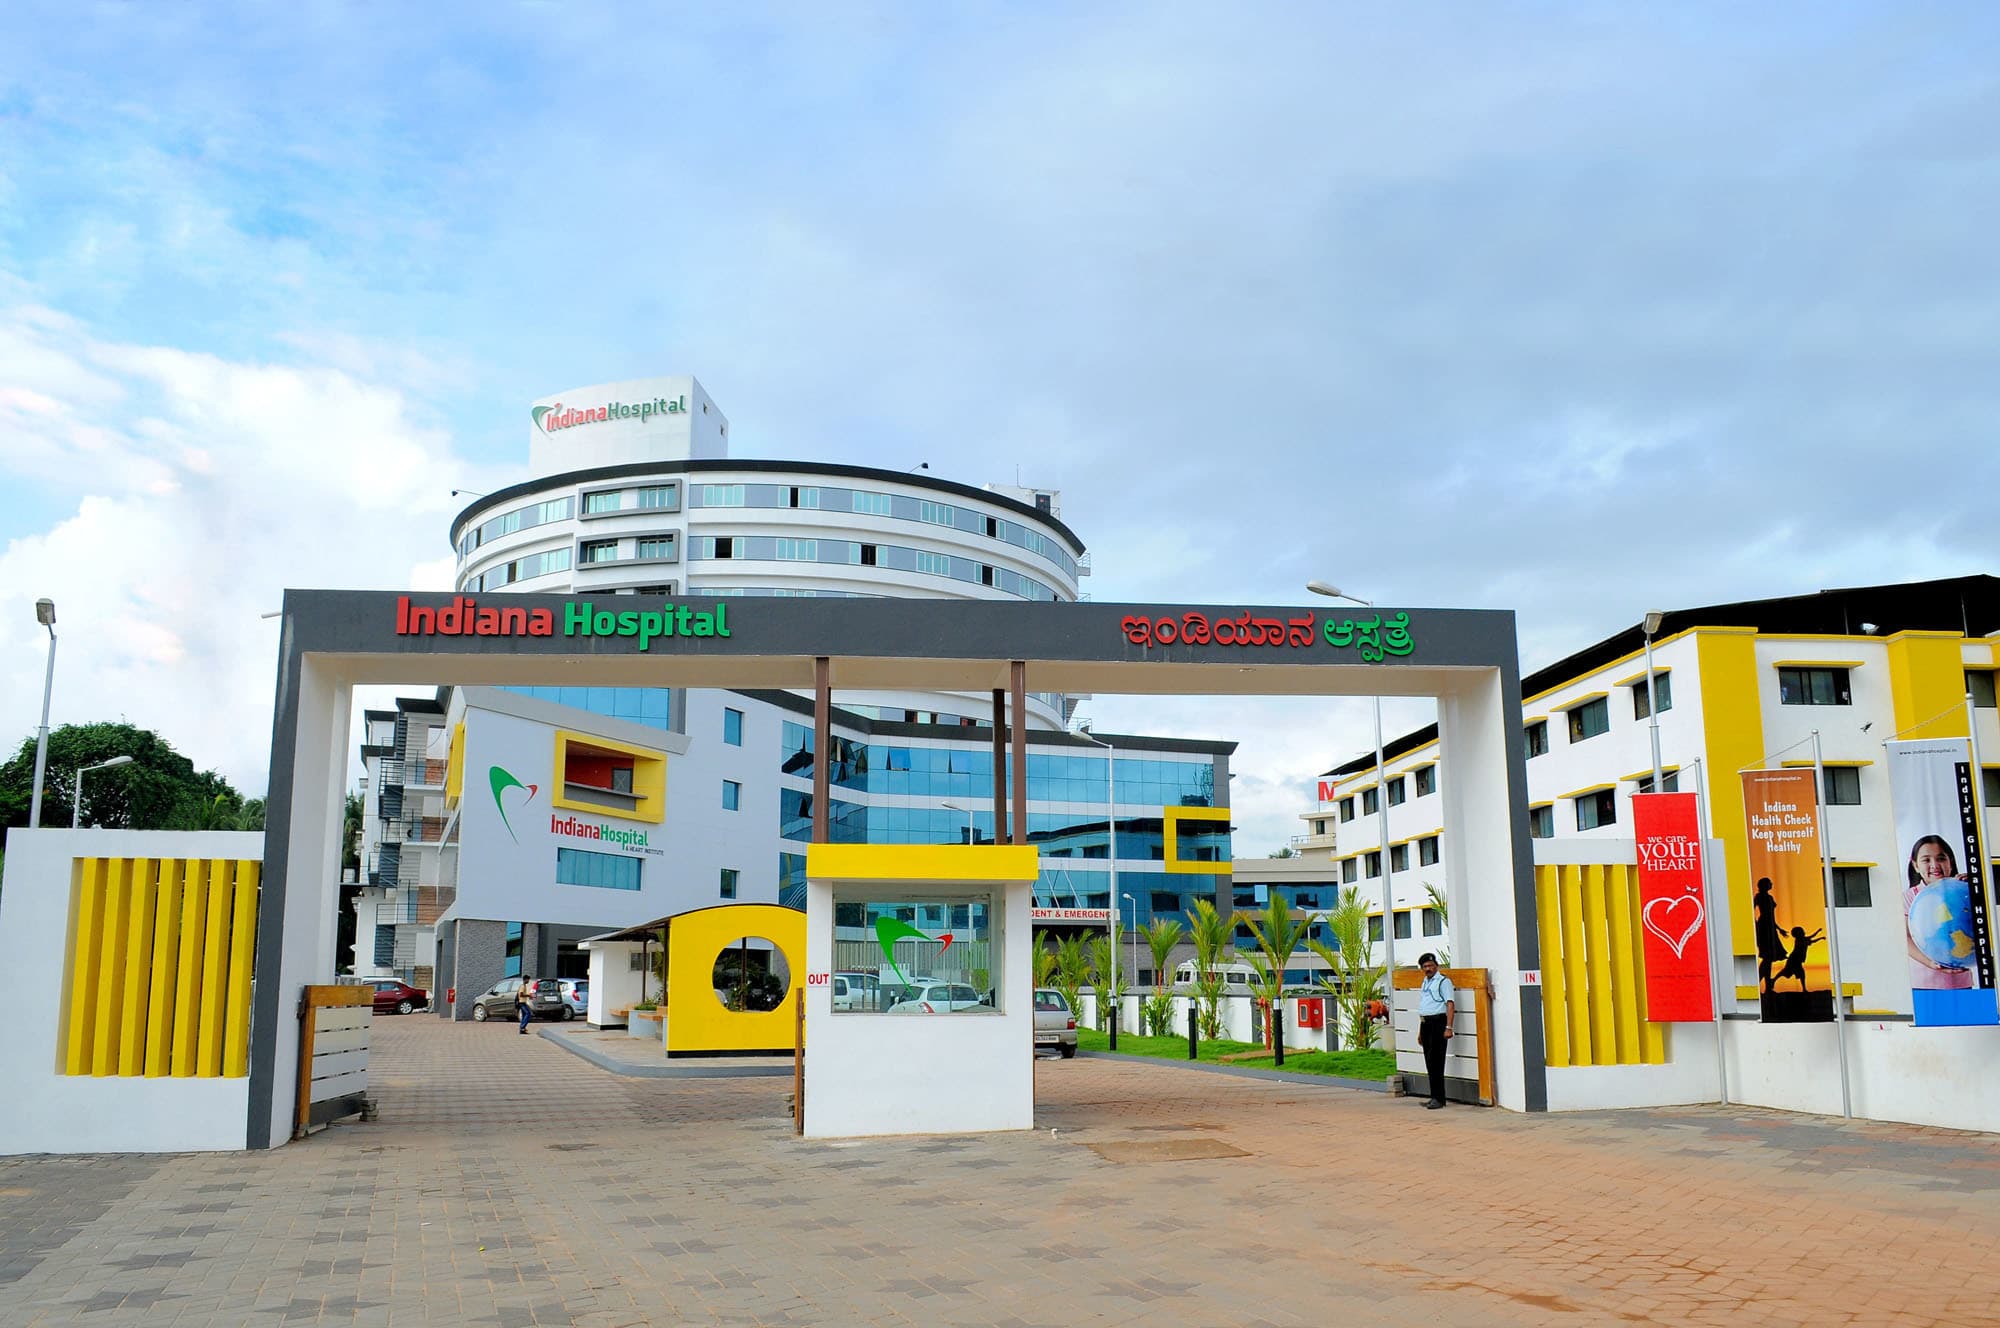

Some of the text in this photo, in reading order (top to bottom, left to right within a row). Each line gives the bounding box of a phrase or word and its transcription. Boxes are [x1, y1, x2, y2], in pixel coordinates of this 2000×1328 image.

[396, 596, 731, 651] Indiana Hospital
[1120, 609, 1315, 648] ಇಂಡಿಯಾನ
[1764, 801, 1797, 813] Indiana
[1752, 813, 1812, 826] Health Check
[1665, 835, 1687, 843] care
[1752, 827, 1814, 842] Keep yourself
[1637, 841, 1699, 865] your
[1767, 840, 1802, 854] Healthy
[1647, 858, 1697, 871] HEART
[1055, 909, 1061, 918] &
[1064, 910, 1111, 919] EMERGENC
[1967, 835, 1979, 894] Global
[1975, 905, 1989, 986] Hospital
[808, 974, 829, 984] OUT
[1525, 972, 1536, 983] IN
